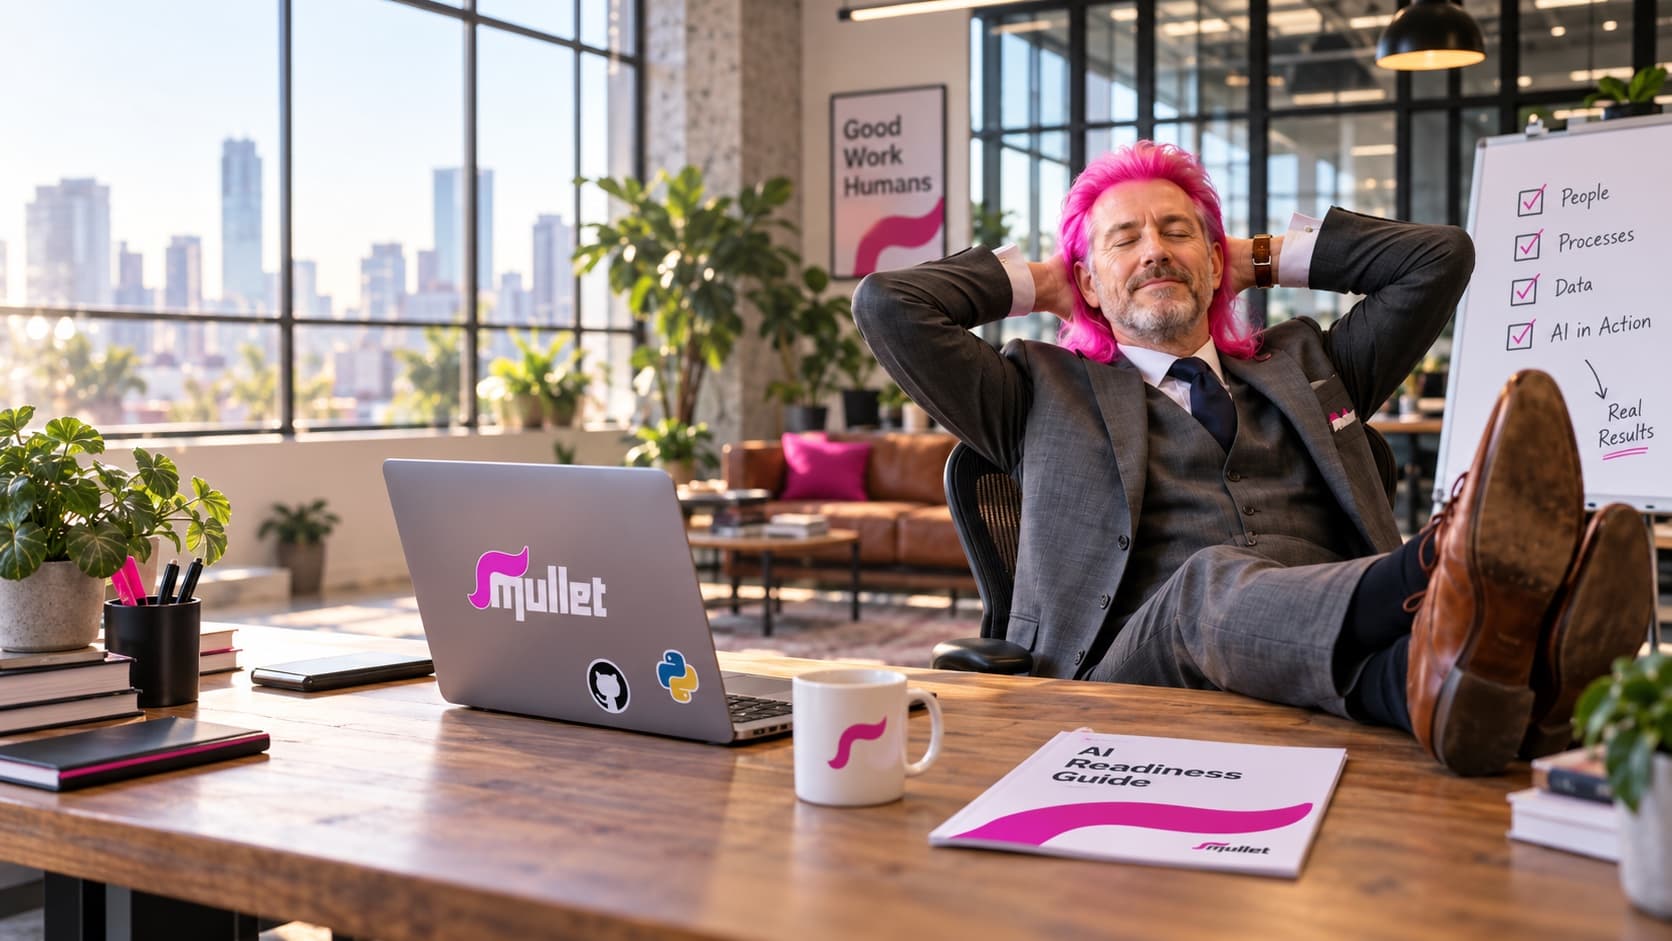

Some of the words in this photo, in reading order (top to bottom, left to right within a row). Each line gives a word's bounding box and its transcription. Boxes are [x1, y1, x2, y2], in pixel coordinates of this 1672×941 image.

[842, 114, 902, 140] Good
[843, 143, 903, 169] Work
[843, 174, 933, 197] Humans
[1561, 183, 1610, 209] People
[1558, 229, 1635, 252] Processes
[1554, 276, 1593, 297] Data
[1550, 322, 1569, 343] AI
[1576, 321, 1591, 339] in
[1598, 315, 1652, 337] Action
[1607, 398, 1642, 422] Real
[1598, 423, 1655, 448] Results
[490, 565, 607, 622] mullet
[1077, 745, 1115, 758] AI
[1051, 770, 1152, 788] Guide
[1064, 758, 1243, 781] Readiness
[1206, 845, 1271, 855] mullet
